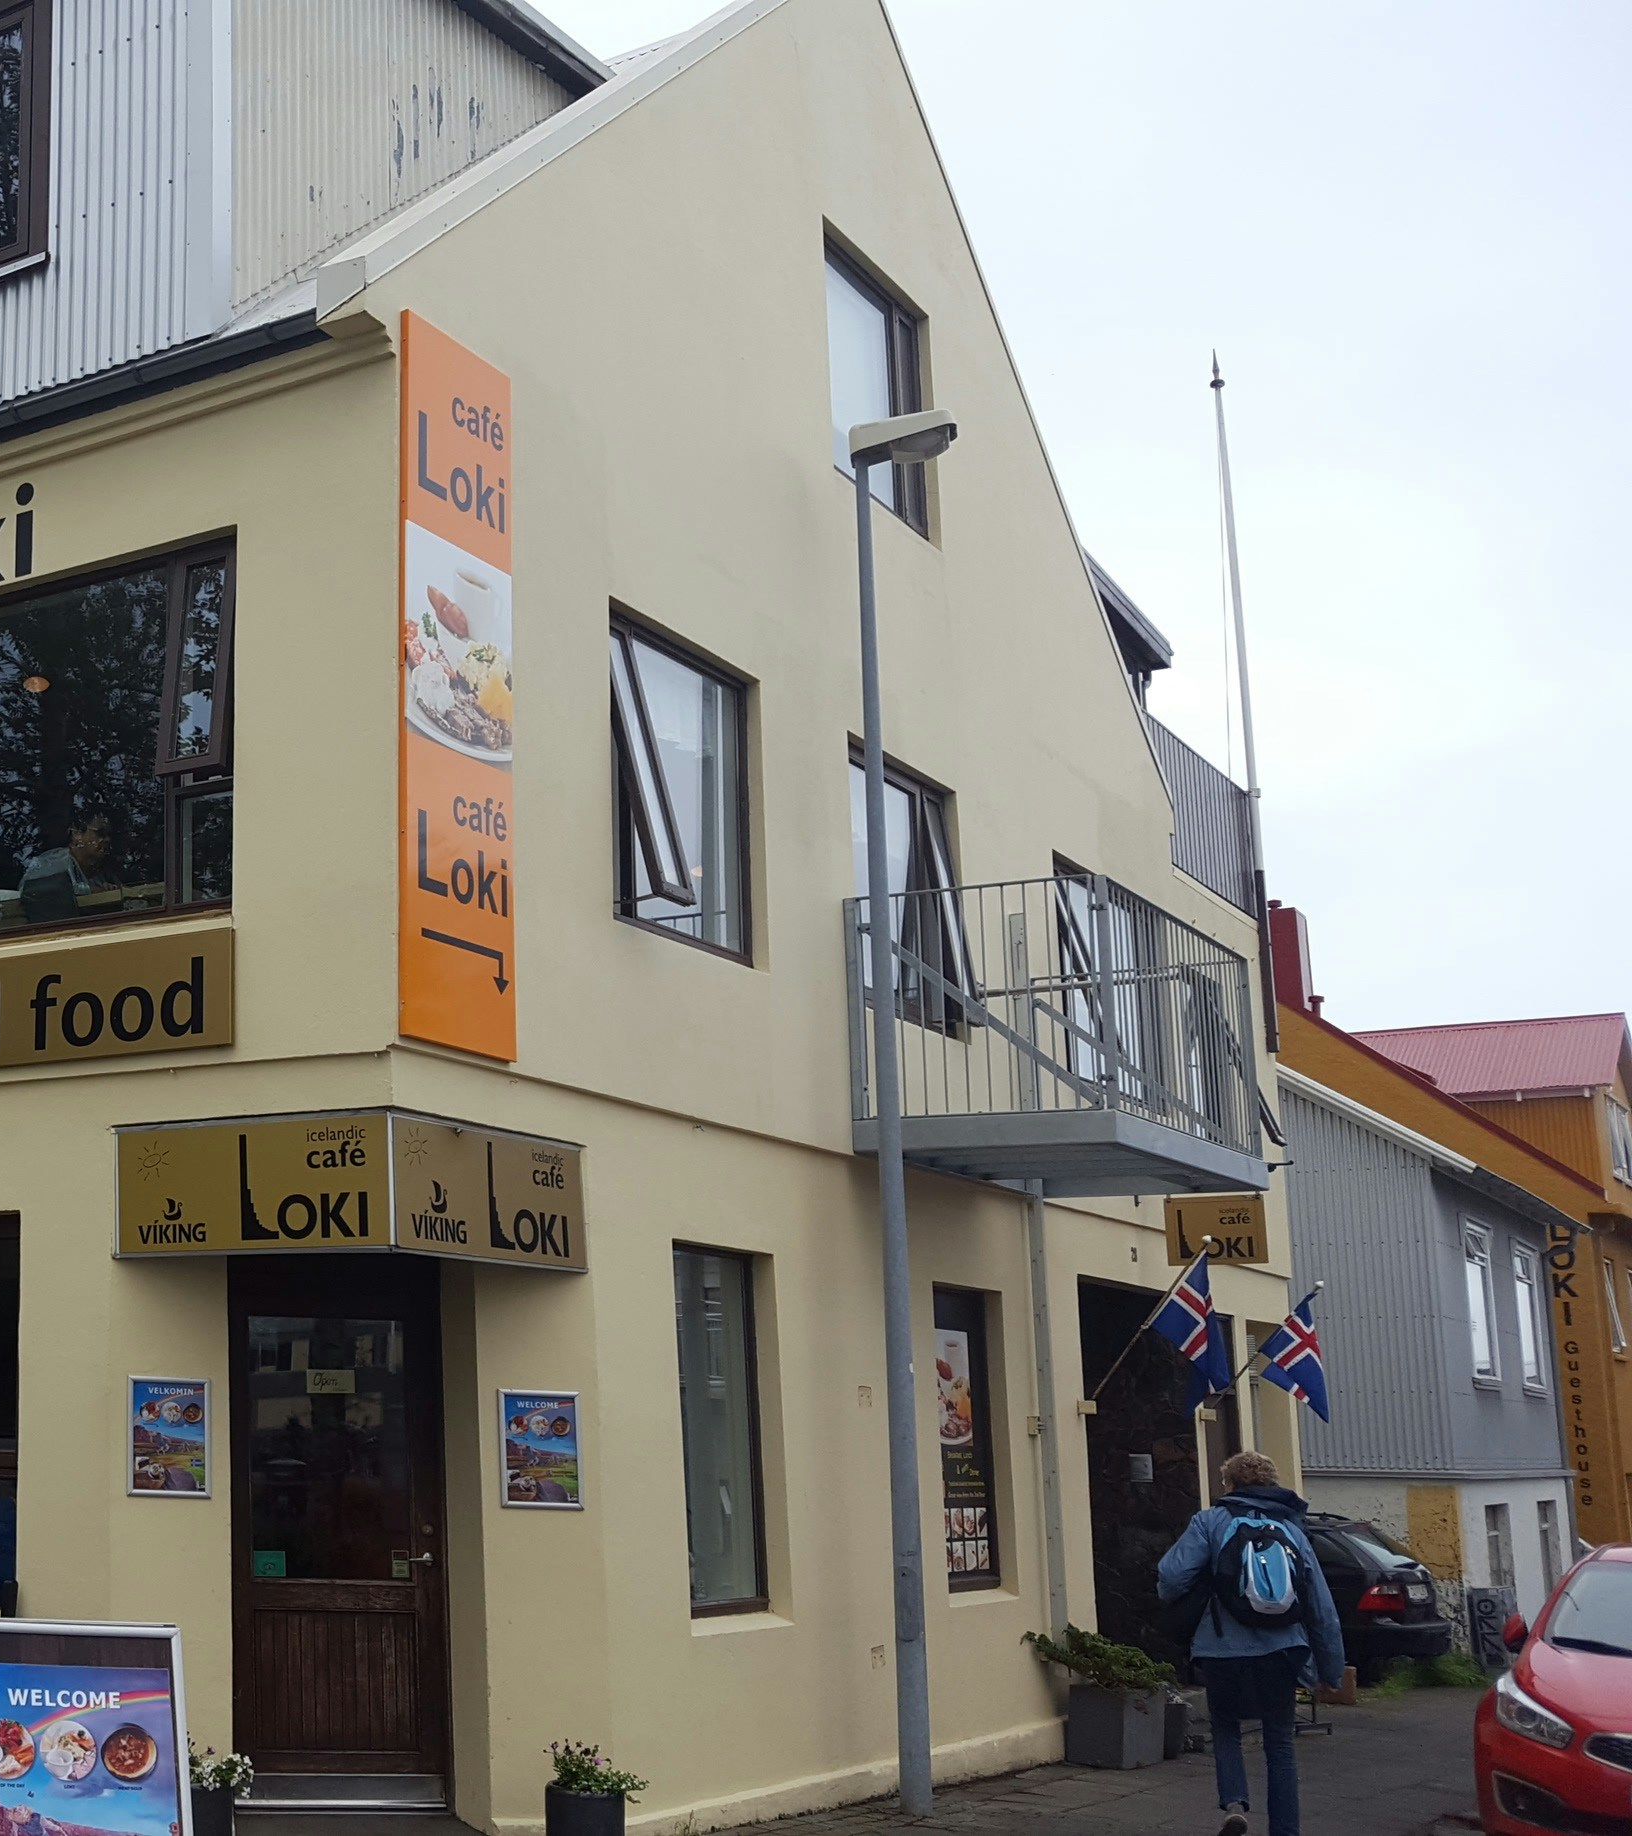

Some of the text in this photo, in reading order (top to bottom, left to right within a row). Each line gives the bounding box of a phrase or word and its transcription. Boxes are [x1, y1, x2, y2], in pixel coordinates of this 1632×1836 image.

[451, 396, 505, 452] café
[417, 409, 506, 535] Loki
[452, 795, 508, 842] café
[417, 807, 509, 918] Loki
[29, 955, 206, 1051] food
[306, 1125, 367, 1142] icelandic
[306, 1140, 367, 1169] café
[531, 1149, 565, 1167] icelandic
[238, 1133, 369, 1241] LOKI
[531, 1165, 565, 1190] café
[486, 1141, 571, 1259] LOKI
[137, 1219, 207, 1245] VÍKING
[410, 1209, 468, 1245] VÍKING
[1176, 1209, 1255, 1259] LOKI
[1219, 1212, 1252, 1225] café
[148, 1385, 195, 1397] VELKOMIN
[516, 1400, 560, 1410] WELCOME
[1564, 1340, 1594, 1507] Guesthouse
[7, 1687, 122, 1710] WELCOME
